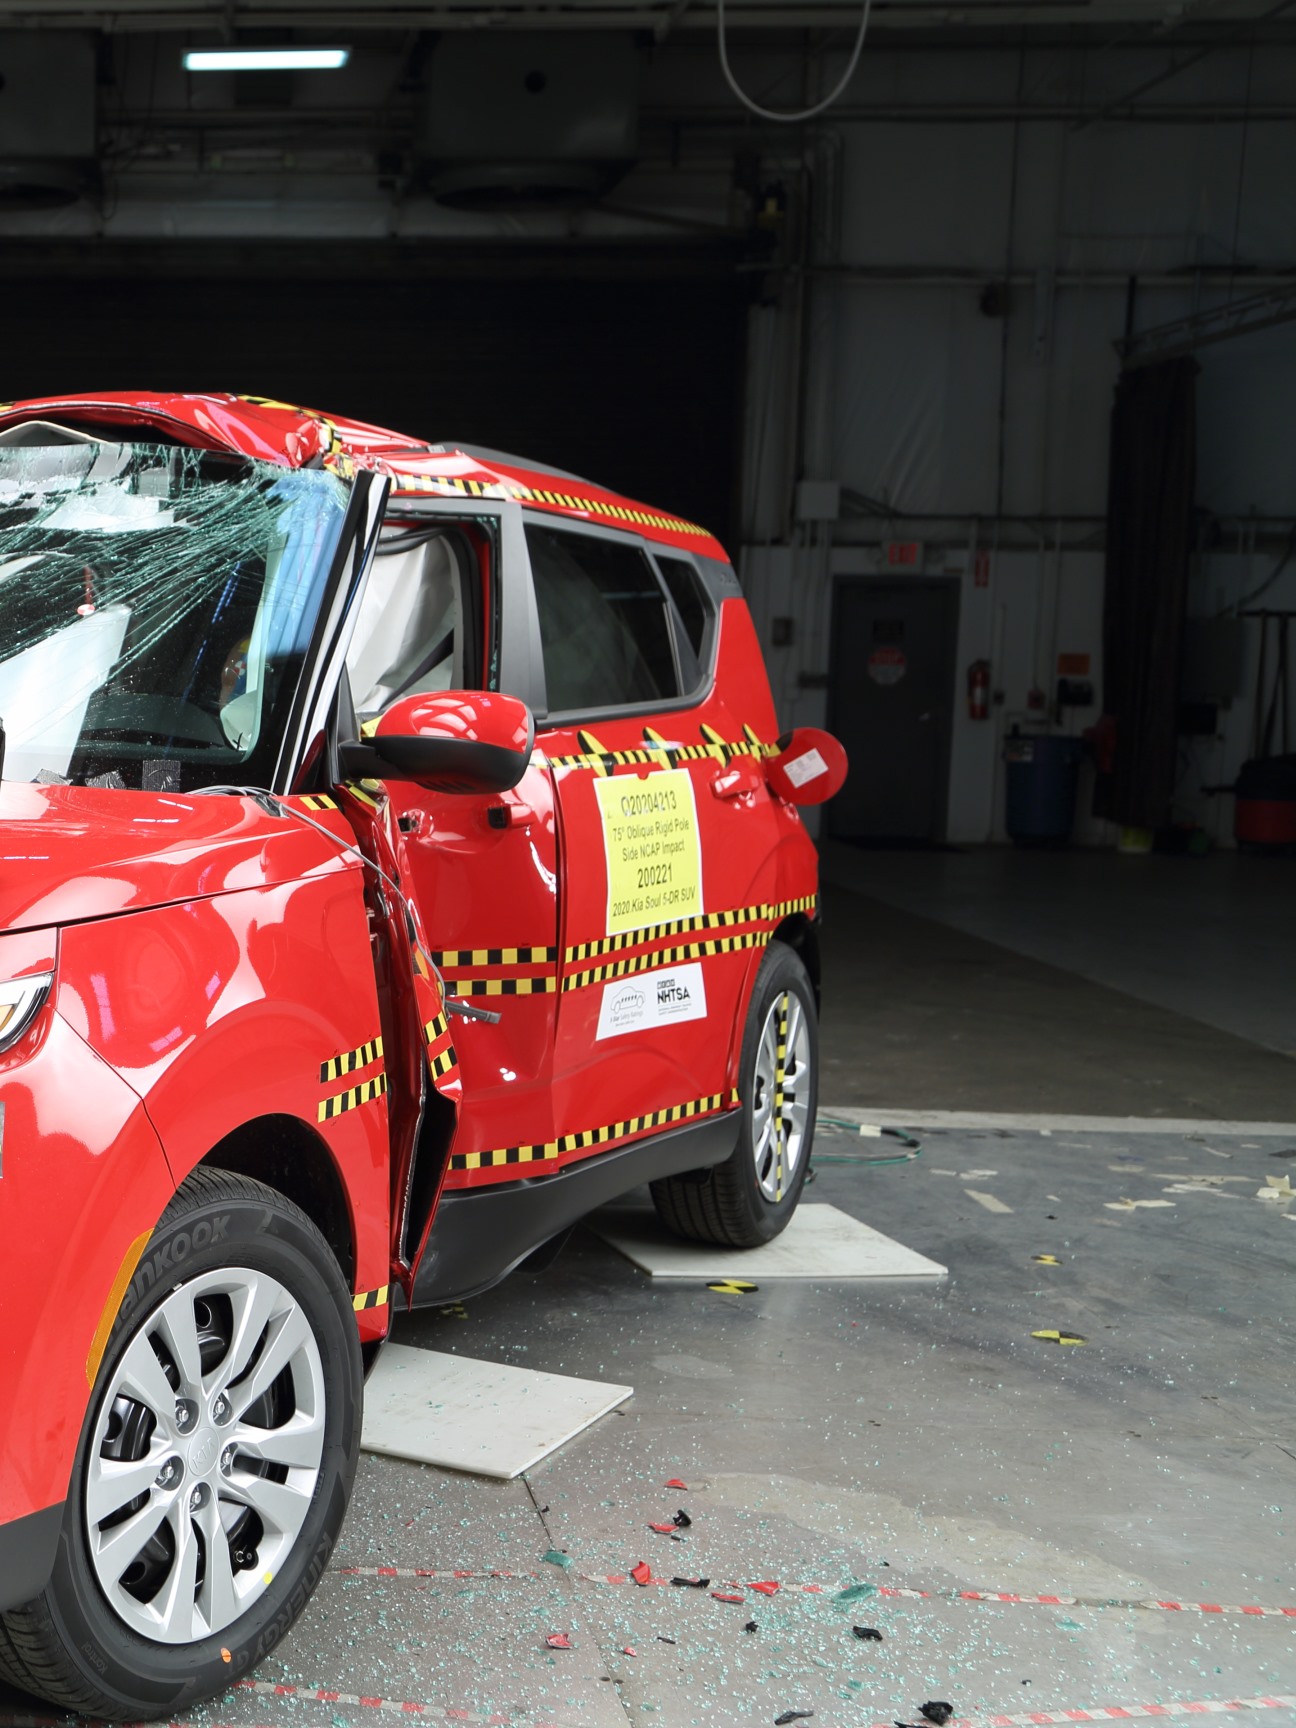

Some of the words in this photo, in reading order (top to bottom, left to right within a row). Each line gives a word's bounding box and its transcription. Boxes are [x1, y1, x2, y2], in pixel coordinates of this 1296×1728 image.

[888, 543, 918, 565] EXIT
[621, 790, 677, 817] Q20204213
[627, 824, 654, 840] Oblique
[655, 819, 673, 837] Rigid
[674, 817, 689, 832] Pole
[622, 846, 639, 863] Side
[639, 842, 661, 859] NCAP
[662, 839, 685, 858] Impact
[637, 862, 673, 889] 200221
[613, 900, 631, 917] 2020
[631, 897, 643, 913] Kia
[645, 893, 662, 910] Soul
[663, 889, 679, 906] 5-DR
[681, 885, 696, 902] SUV
[657, 985, 691, 1004] NHTSA
